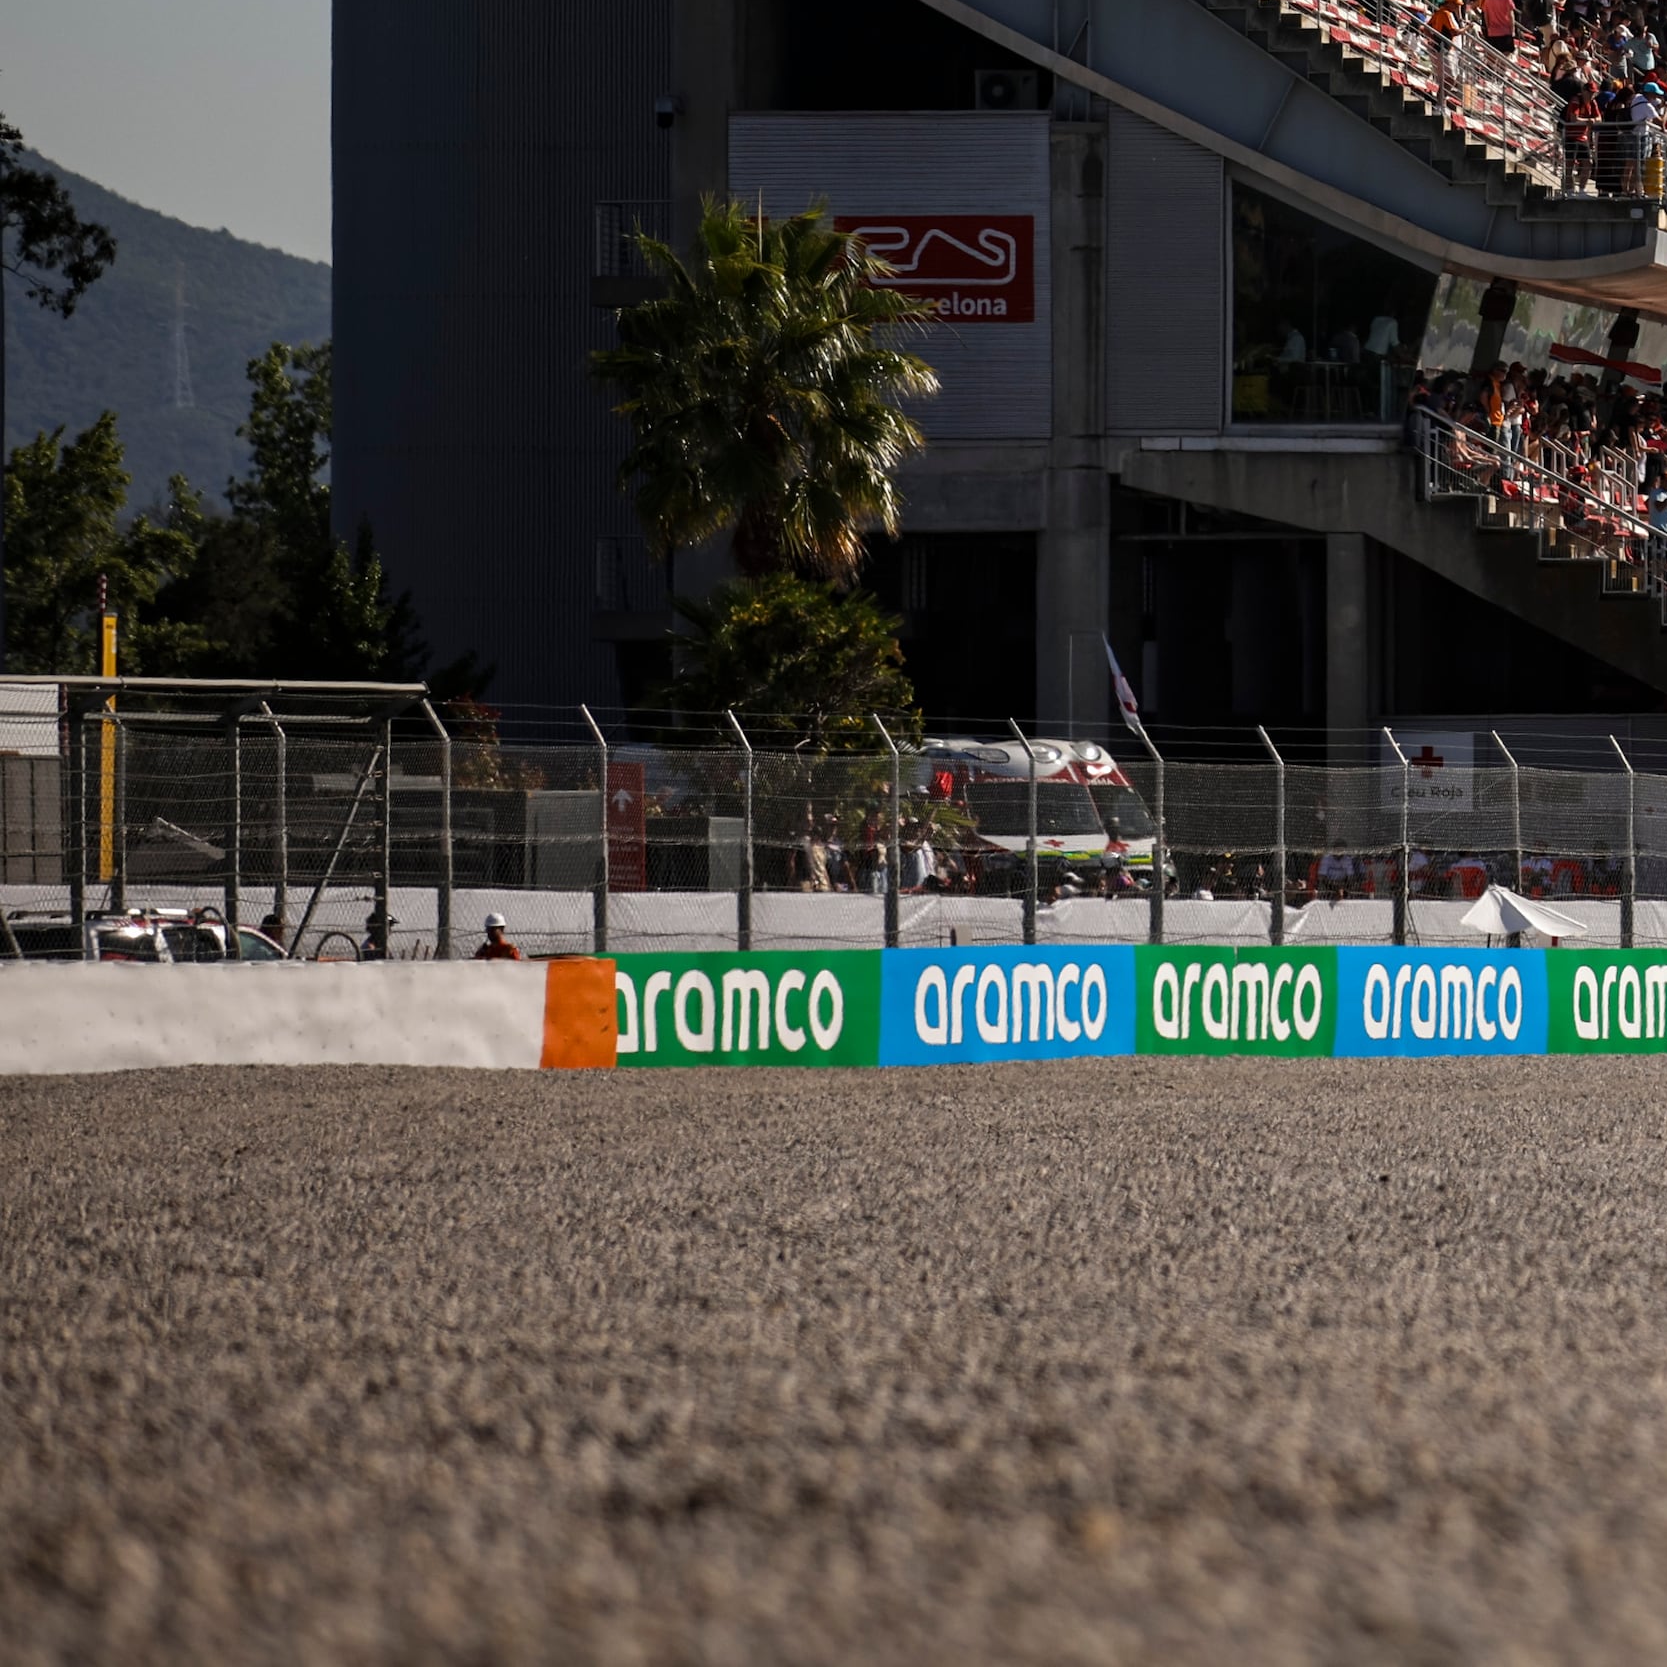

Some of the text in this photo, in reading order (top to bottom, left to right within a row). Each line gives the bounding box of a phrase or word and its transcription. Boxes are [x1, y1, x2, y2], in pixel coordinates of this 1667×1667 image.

[915, 963, 1106, 1045] aramco
[1153, 962, 1322, 1041] aramco
[1363, 963, 1522, 1041] aramco
